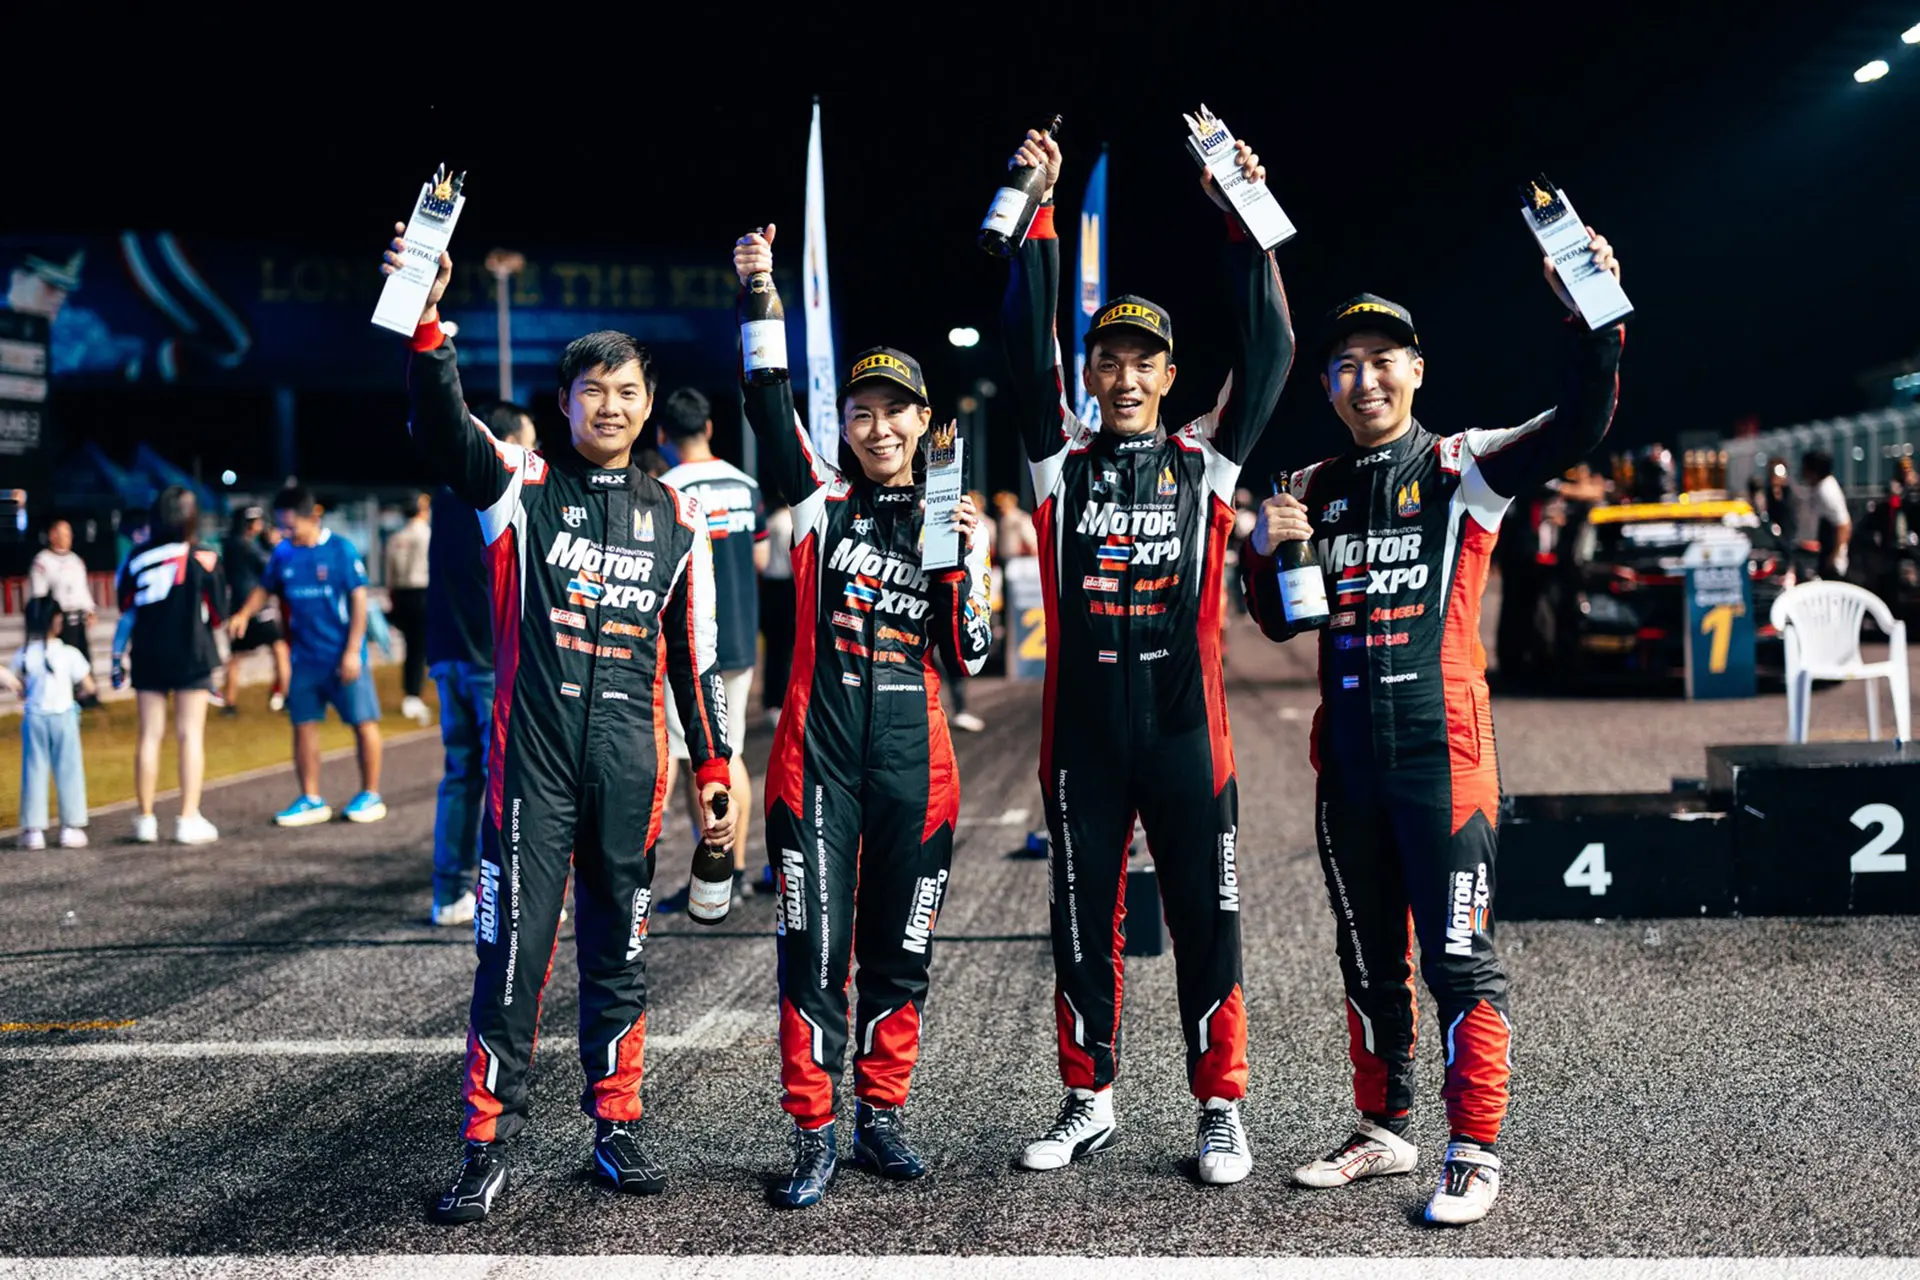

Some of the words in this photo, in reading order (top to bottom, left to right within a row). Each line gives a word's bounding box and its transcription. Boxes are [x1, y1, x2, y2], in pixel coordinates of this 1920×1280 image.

[1223, 175, 1247, 191] OVER
[1119, 439, 1154, 450] HRX
[1356, 450, 1392, 467] HRX
[592, 475, 627, 484] HRX
[878, 493, 913, 502] HRX
[927, 494, 959, 505] OVERALL
[1076, 500, 1176, 537] MOTOR
[545, 531, 654, 583] MOTOR
[829, 538, 931, 593] MOTOR
[1318, 534, 1422, 575] MOTOR
[1140, 648, 1169, 661] NUNZA
[1849, 803, 1907, 872] 2
[782, 848, 804, 931] MOTOR
[817, 838, 829, 903] autoinfo.co.th
[1219, 832, 1240, 912] MOTOR
[1563, 843, 1612, 896] 4
[480, 859, 501, 943] MOTOR
[902, 877, 937, 954] MOTOR
[1445, 871, 1474, 956] MOTOR
[821, 913, 829, 989] motorexpo.co.th
